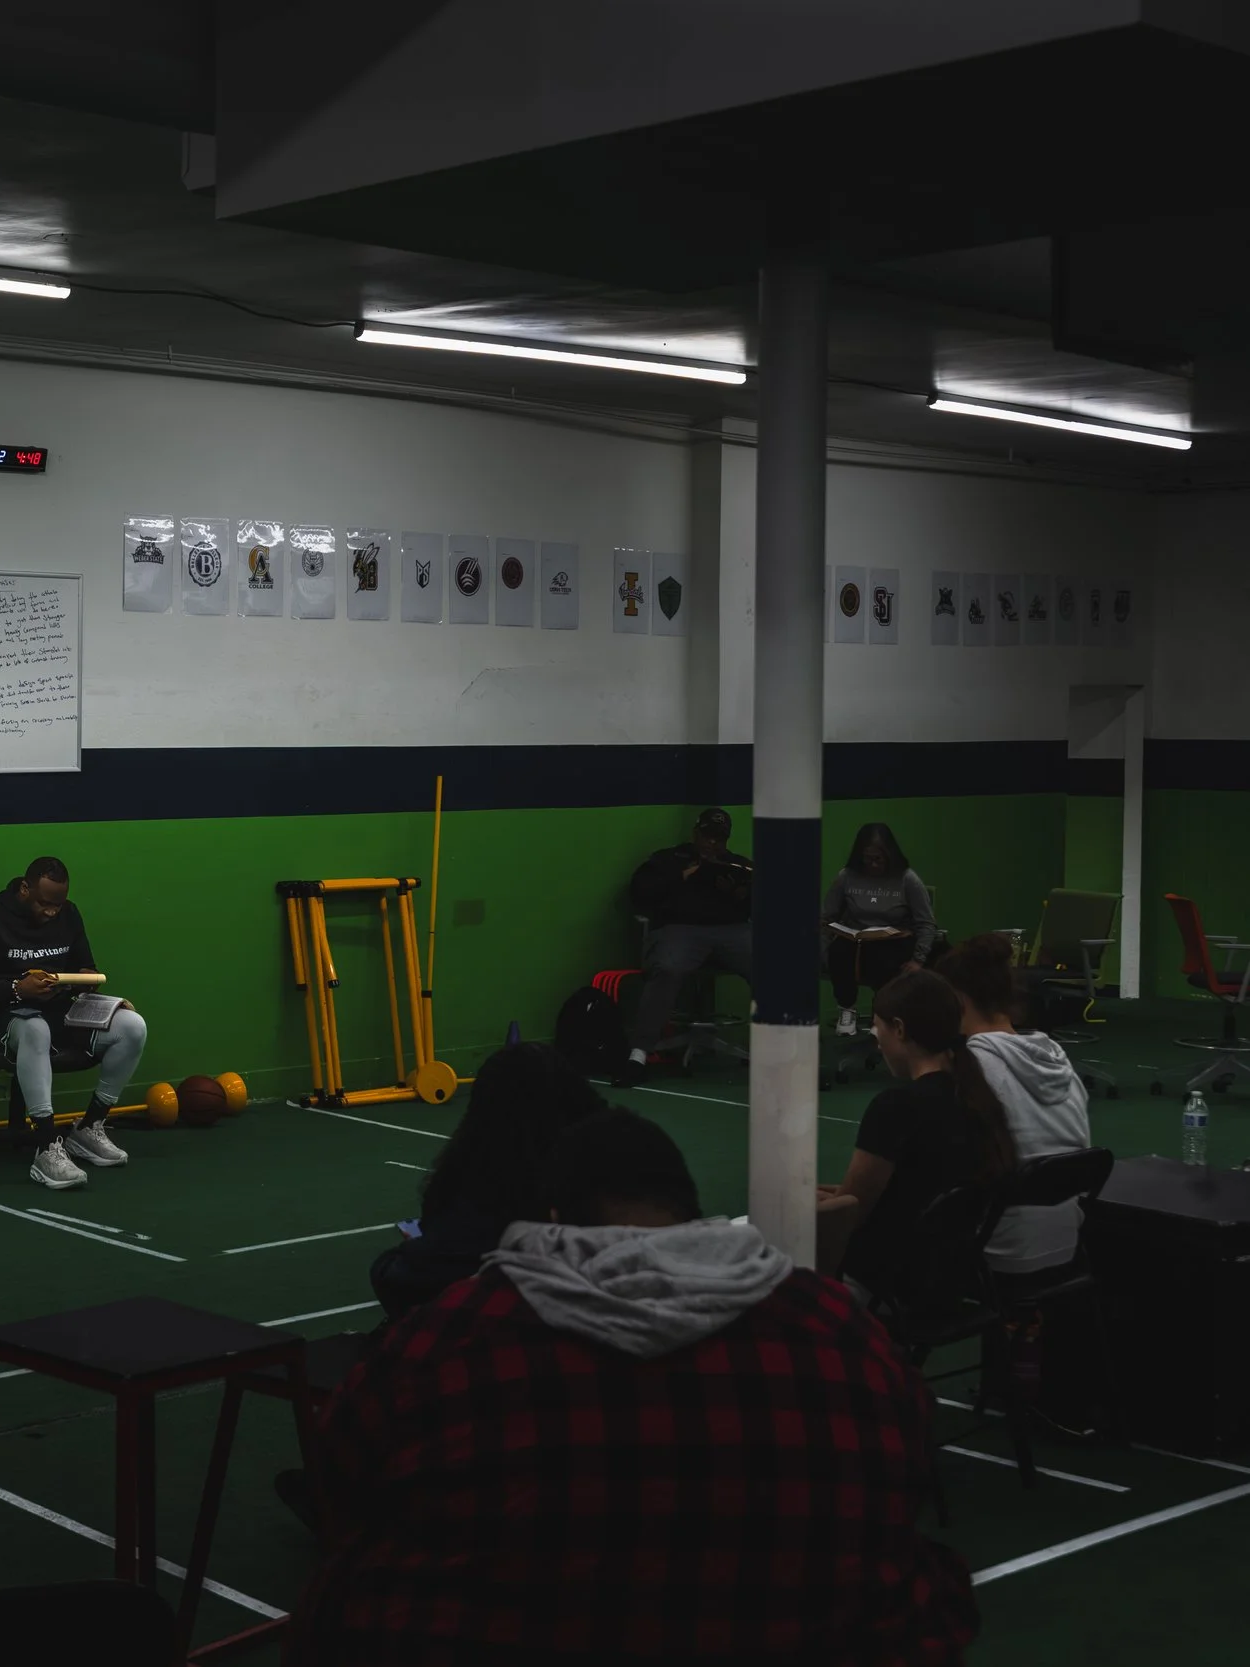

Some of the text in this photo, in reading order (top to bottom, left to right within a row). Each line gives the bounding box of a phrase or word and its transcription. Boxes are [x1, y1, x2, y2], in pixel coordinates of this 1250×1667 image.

[16, 451, 41, 465] 4:48
[199, 554, 214, 575] B
[8, 946, 70, 960] #BigWuFitness
